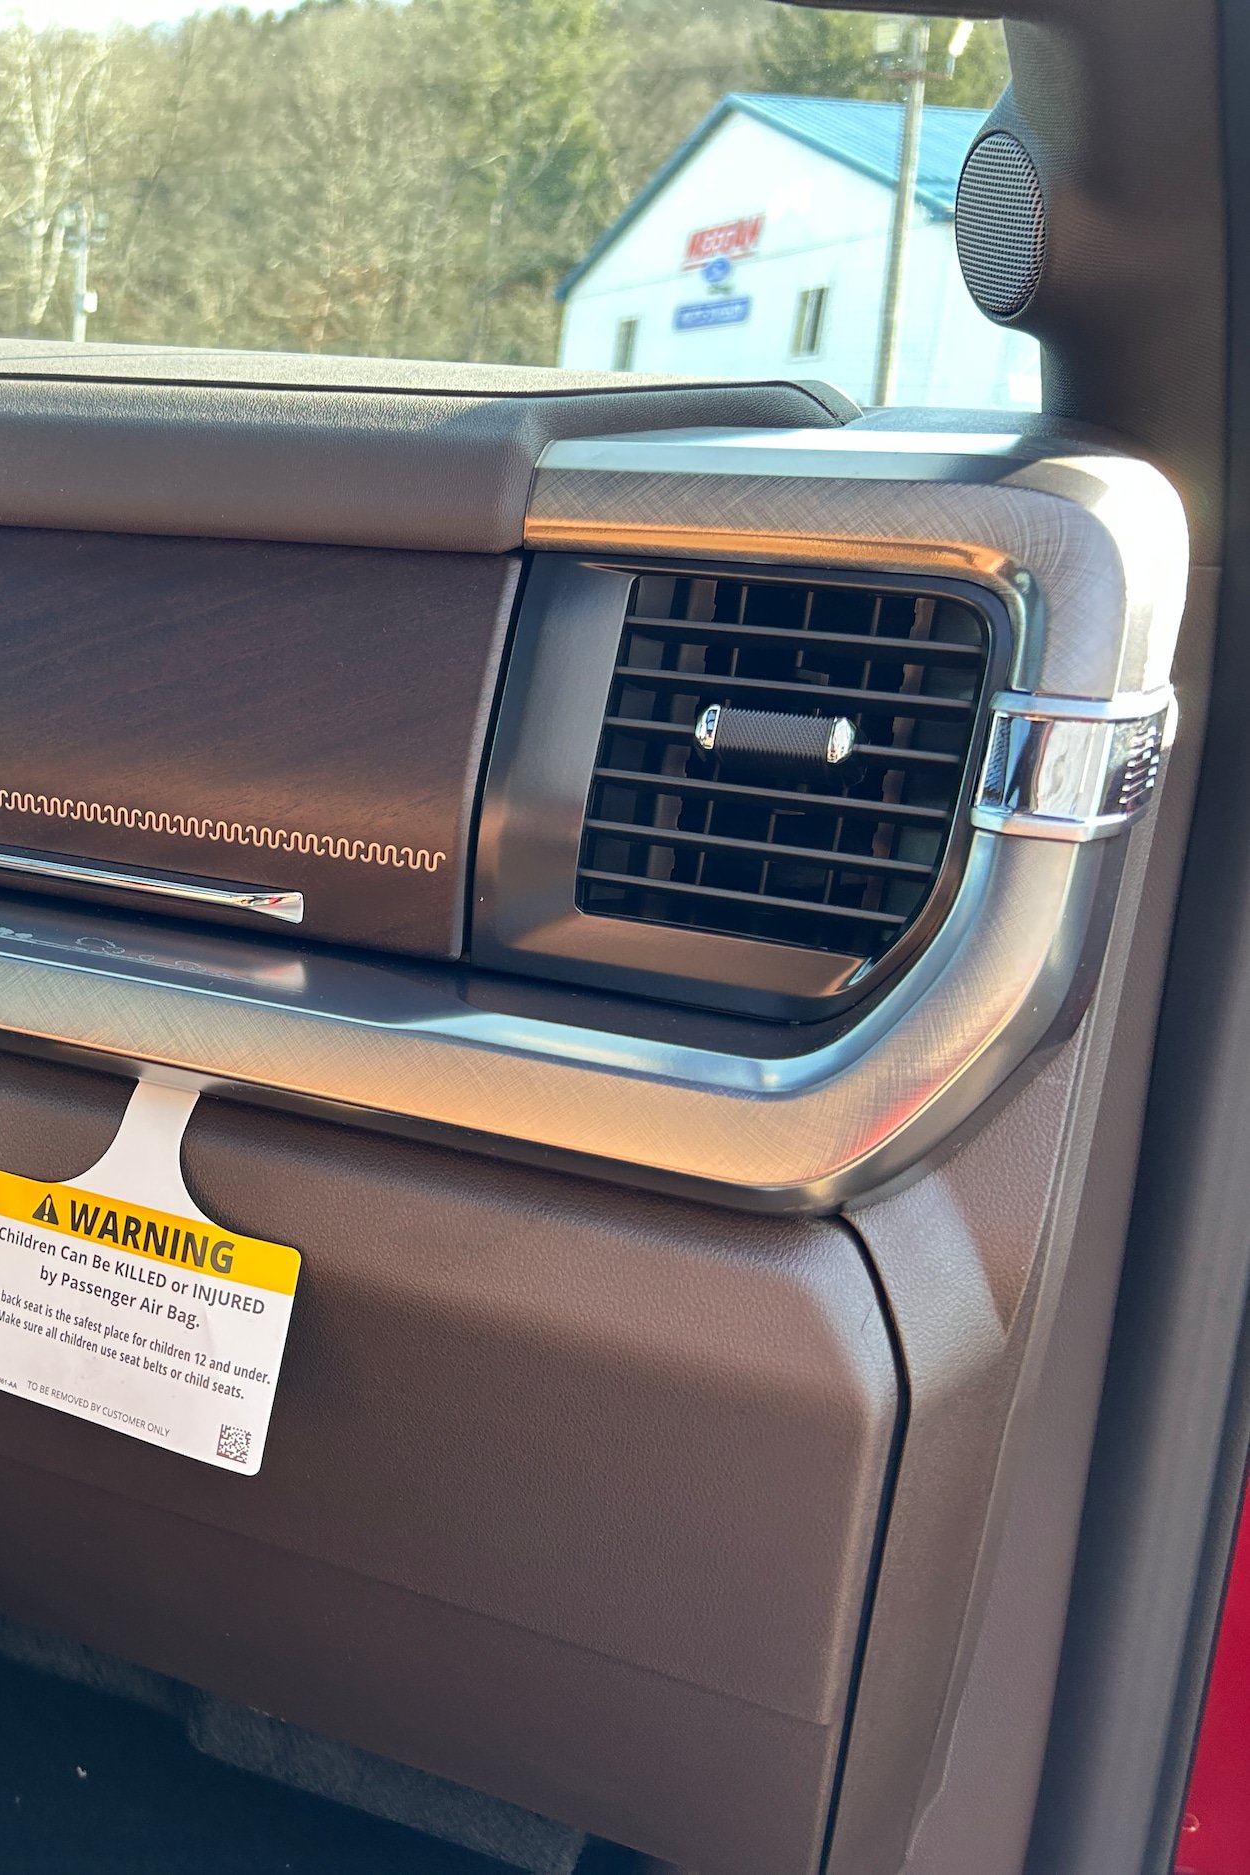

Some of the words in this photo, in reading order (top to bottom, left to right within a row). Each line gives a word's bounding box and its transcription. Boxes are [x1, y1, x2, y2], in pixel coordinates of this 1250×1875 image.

[70, 1199, 236, 1274] WARNING
[40, 1265, 58, 1286] by
[61, 1272, 137, 1307] Passenger
[139, 1297, 163, 1316] Air
[167, 1304, 200, 1330] Bag.
[61, 1245, 88, 1265] Can
[92, 1254, 111, 1272] Be
[115, 1261, 167, 1288] KILLED
[171, 1280, 189, 1295] or
[193, 1283, 265, 1315] INJURED
[0, 1289, 22, 1308] back
[23, 1299, 43, 1315] seat
[45, 1304, 53, 1318] is
[55, 1308, 72, 1324] the
[73, 1314, 101, 1334] safest
[103, 1325, 130, 1343] place
[132, 1332, 148, 1348] for
[149, 1339, 191, 1362] children
[194, 1352, 207, 1367] 12
[209, 1358, 232, 1374] and
[233, 1364, 271, 1385] under.
[23, 1319, 44, 1335] sure
[45, 1325, 58, 1340] all
[59, 1330, 98, 1353] children
[100, 1345, 118, 1360] use
[119, 1352, 141, 1368] seat
[143, 1356, 168, 1376] belts
[170, 1366, 183, 1381] or
[184, 1370, 210, 1390] child
[211, 1380, 245, 1400] seats.
[27, 1380, 38, 1392] TO
[39, 1385, 50, 1396] BE
[51, 1388, 90, 1410] REMOVED
[90, 1402, 101, 1414] BY
[102, 1406, 147, 1430] CUSTOMER
[147, 1422, 171, 1438] ONLY
